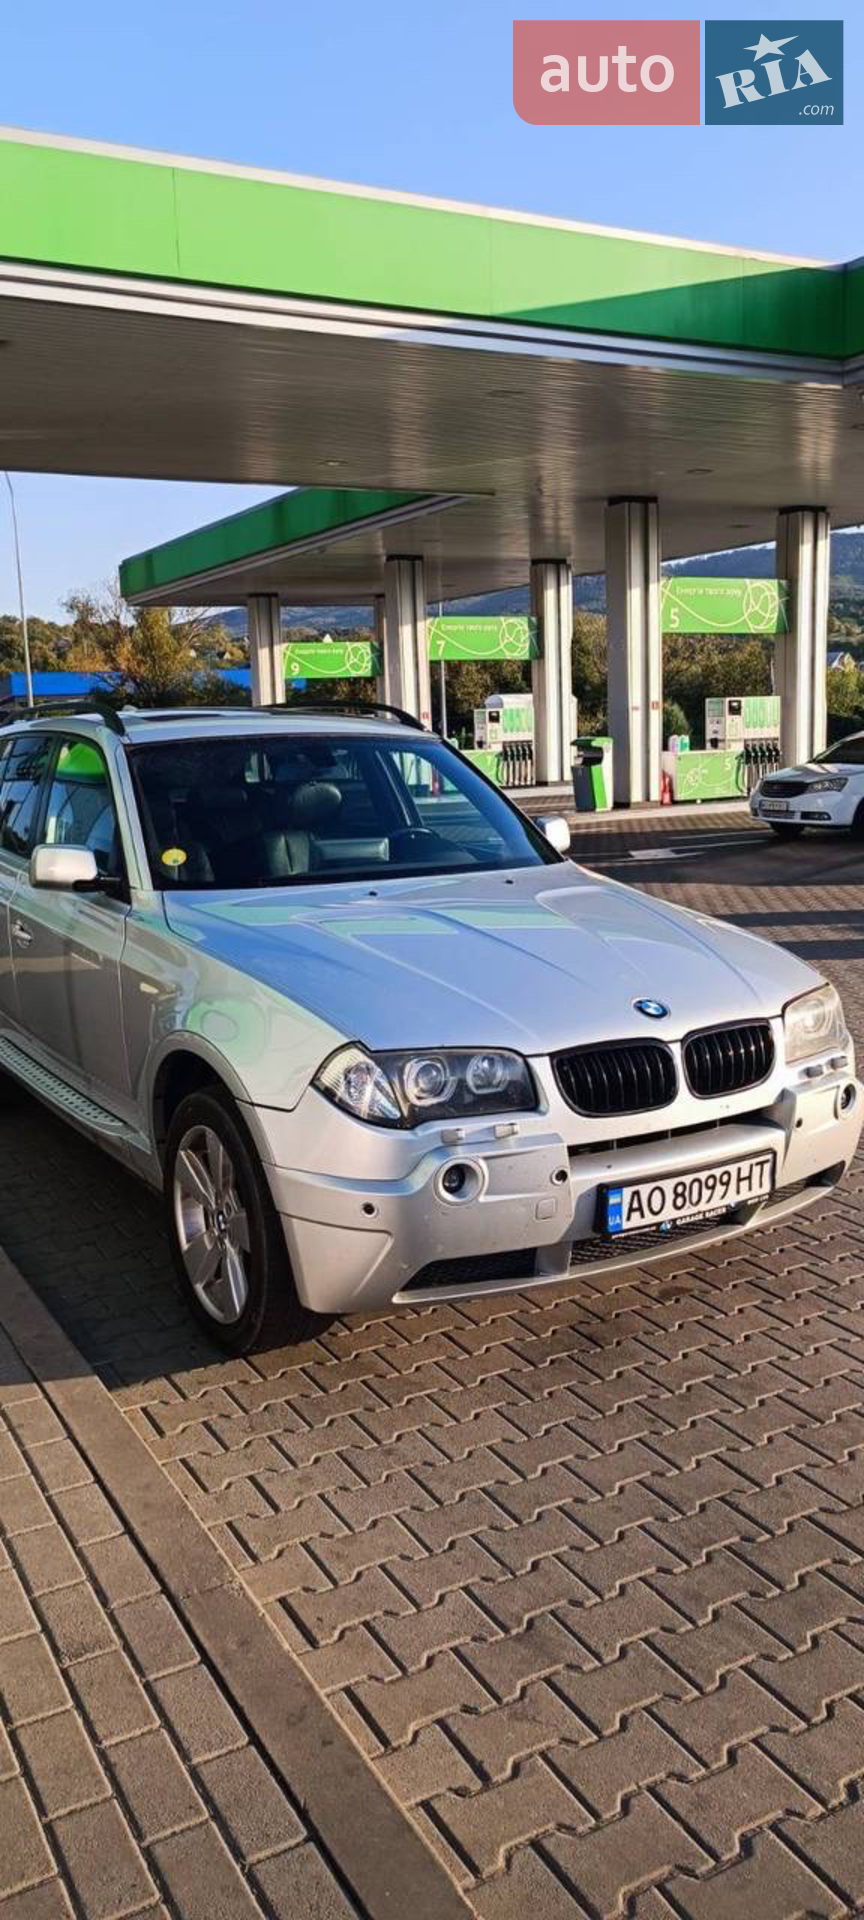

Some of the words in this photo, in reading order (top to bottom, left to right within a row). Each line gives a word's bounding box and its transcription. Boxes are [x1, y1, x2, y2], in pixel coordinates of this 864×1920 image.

[669, 607, 679, 628] 5
[436, 640, 446, 657] 7
[290, 662, 300, 676] 9
[724, 757, 731, 770] 5
[625, 1186, 666, 1222] AO
[672, 1170, 732, 1211] 8099
[736, 1159, 770, 1196] HT
[609, 1215, 622, 1226] UA
